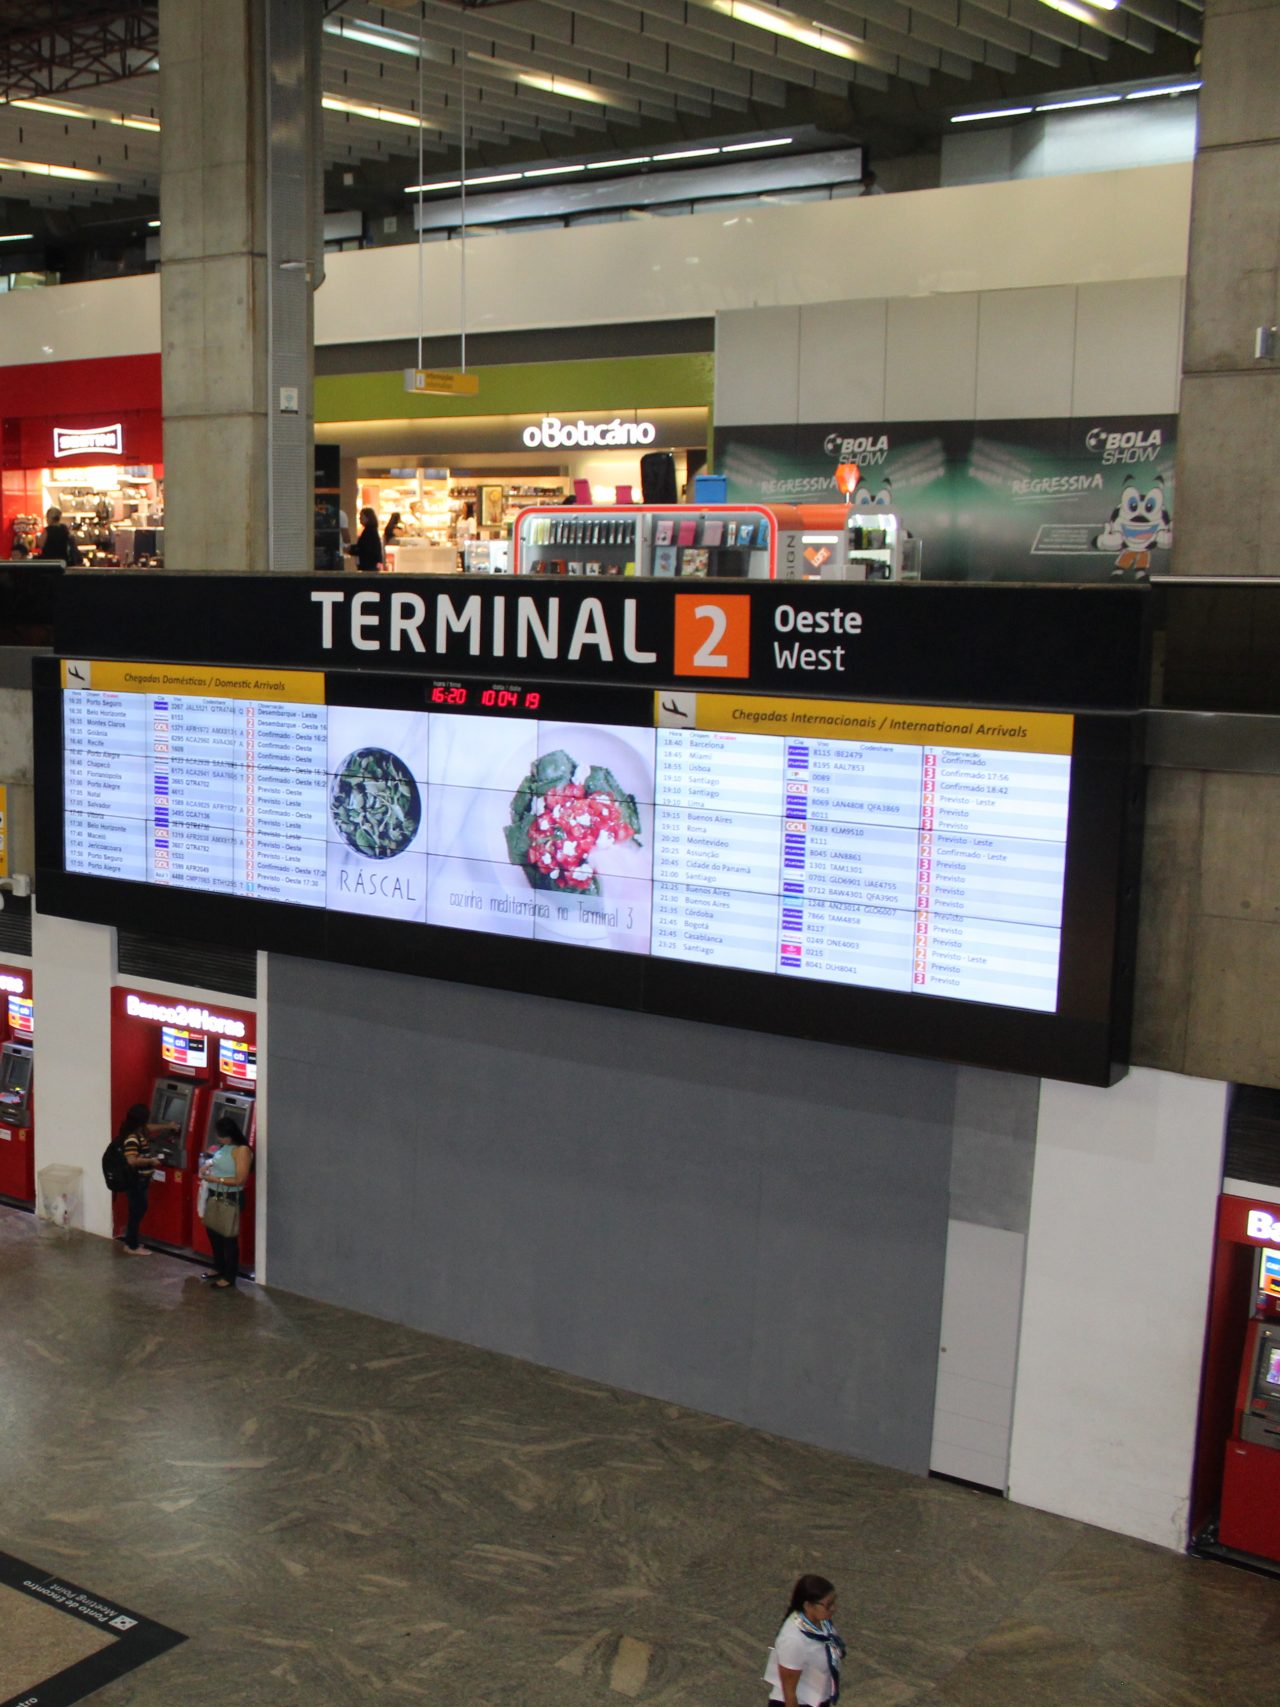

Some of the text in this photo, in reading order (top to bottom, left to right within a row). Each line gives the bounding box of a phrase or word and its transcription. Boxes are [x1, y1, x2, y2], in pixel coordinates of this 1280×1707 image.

[841, 435, 889, 453] BOLA
[1105, 429, 1161, 450] BOLA
[839, 451, 888, 466] SHOW
[1102, 447, 1160, 465] SHOW
[1010, 473, 1104, 494] REGRESSIVA
[311, 591, 729, 667] TERMINAL 2
[774, 605, 862, 634] Oeste
[773, 641, 845, 671] West
[124, 673, 161, 684] Chegadas
[215, 678, 252, 689] Domestic
[253, 680, 285, 691] Arrivals
[432, 687, 467, 705] 16:20
[525, 692, 540, 709] 19
[732, 708, 788, 724] Chegadas
[791, 711, 876, 729] Internacionais
[890, 718, 973, 735] International
[976, 723, 1028, 739] Arrivals
[689, 740, 724, 749] Barcelona
[942, 756, 986, 766] Confirmado
[689, 752, 712, 760] Miami
[941, 769, 985, 779] Confirmado
[987, 773, 1009, 781] 17:56
[689, 764, 711, 772] Lisboa
[940, 782, 984, 793] Confirmado
[986, 786, 1008, 794] 18:42
[689, 776, 719, 786] Santiago
[940, 795, 970, 804] Previsto
[688, 788, 719, 798] Santiago
[939, 808, 969, 817] Previsto
[688, 799, 968, 830] Lima Previsto
[687, 825, 707, 833] Roma
[937, 848, 980, 859] Confirmado
[987, 853, 1007, 861] Leste
[688, 813, 713, 822] Buenos
[714, 816, 732, 824] Aires
[938, 835, 967, 844] Previsto
[974, 839, 993, 847] Leste
[687, 837, 966, 870] Montevideo Previsto
[340, 869, 416, 901] RÁSCAL
[686, 860, 710, 869] Cidade
[711, 863, 721, 871] do
[935, 886, 965, 896] Previsto
[686, 873, 717, 883] Santiago
[935, 899, 964, 909] Previsto
[936, 873, 966, 883] Previsto
[450, 891, 482, 910] cozinha
[558, 908, 568, 921] no
[577, 901, 618, 927] Terminal
[626, 907, 633, 929] 3
[685, 897, 730, 909] Buenos Aires
[684, 932, 723, 943] Casablanca
[931, 963, 960, 973] Previsto
[932, 951, 961, 960] Previsto
[968, 955, 987, 964] Leste
[933, 938, 962, 948] Previsto
[683, 943, 714, 955] Santiago
[930, 976, 960, 986] Previsto
[23, 1580, 109, 1623] Ponto de Encontro
[49, 1583, 119, 1617] Meeting Point
